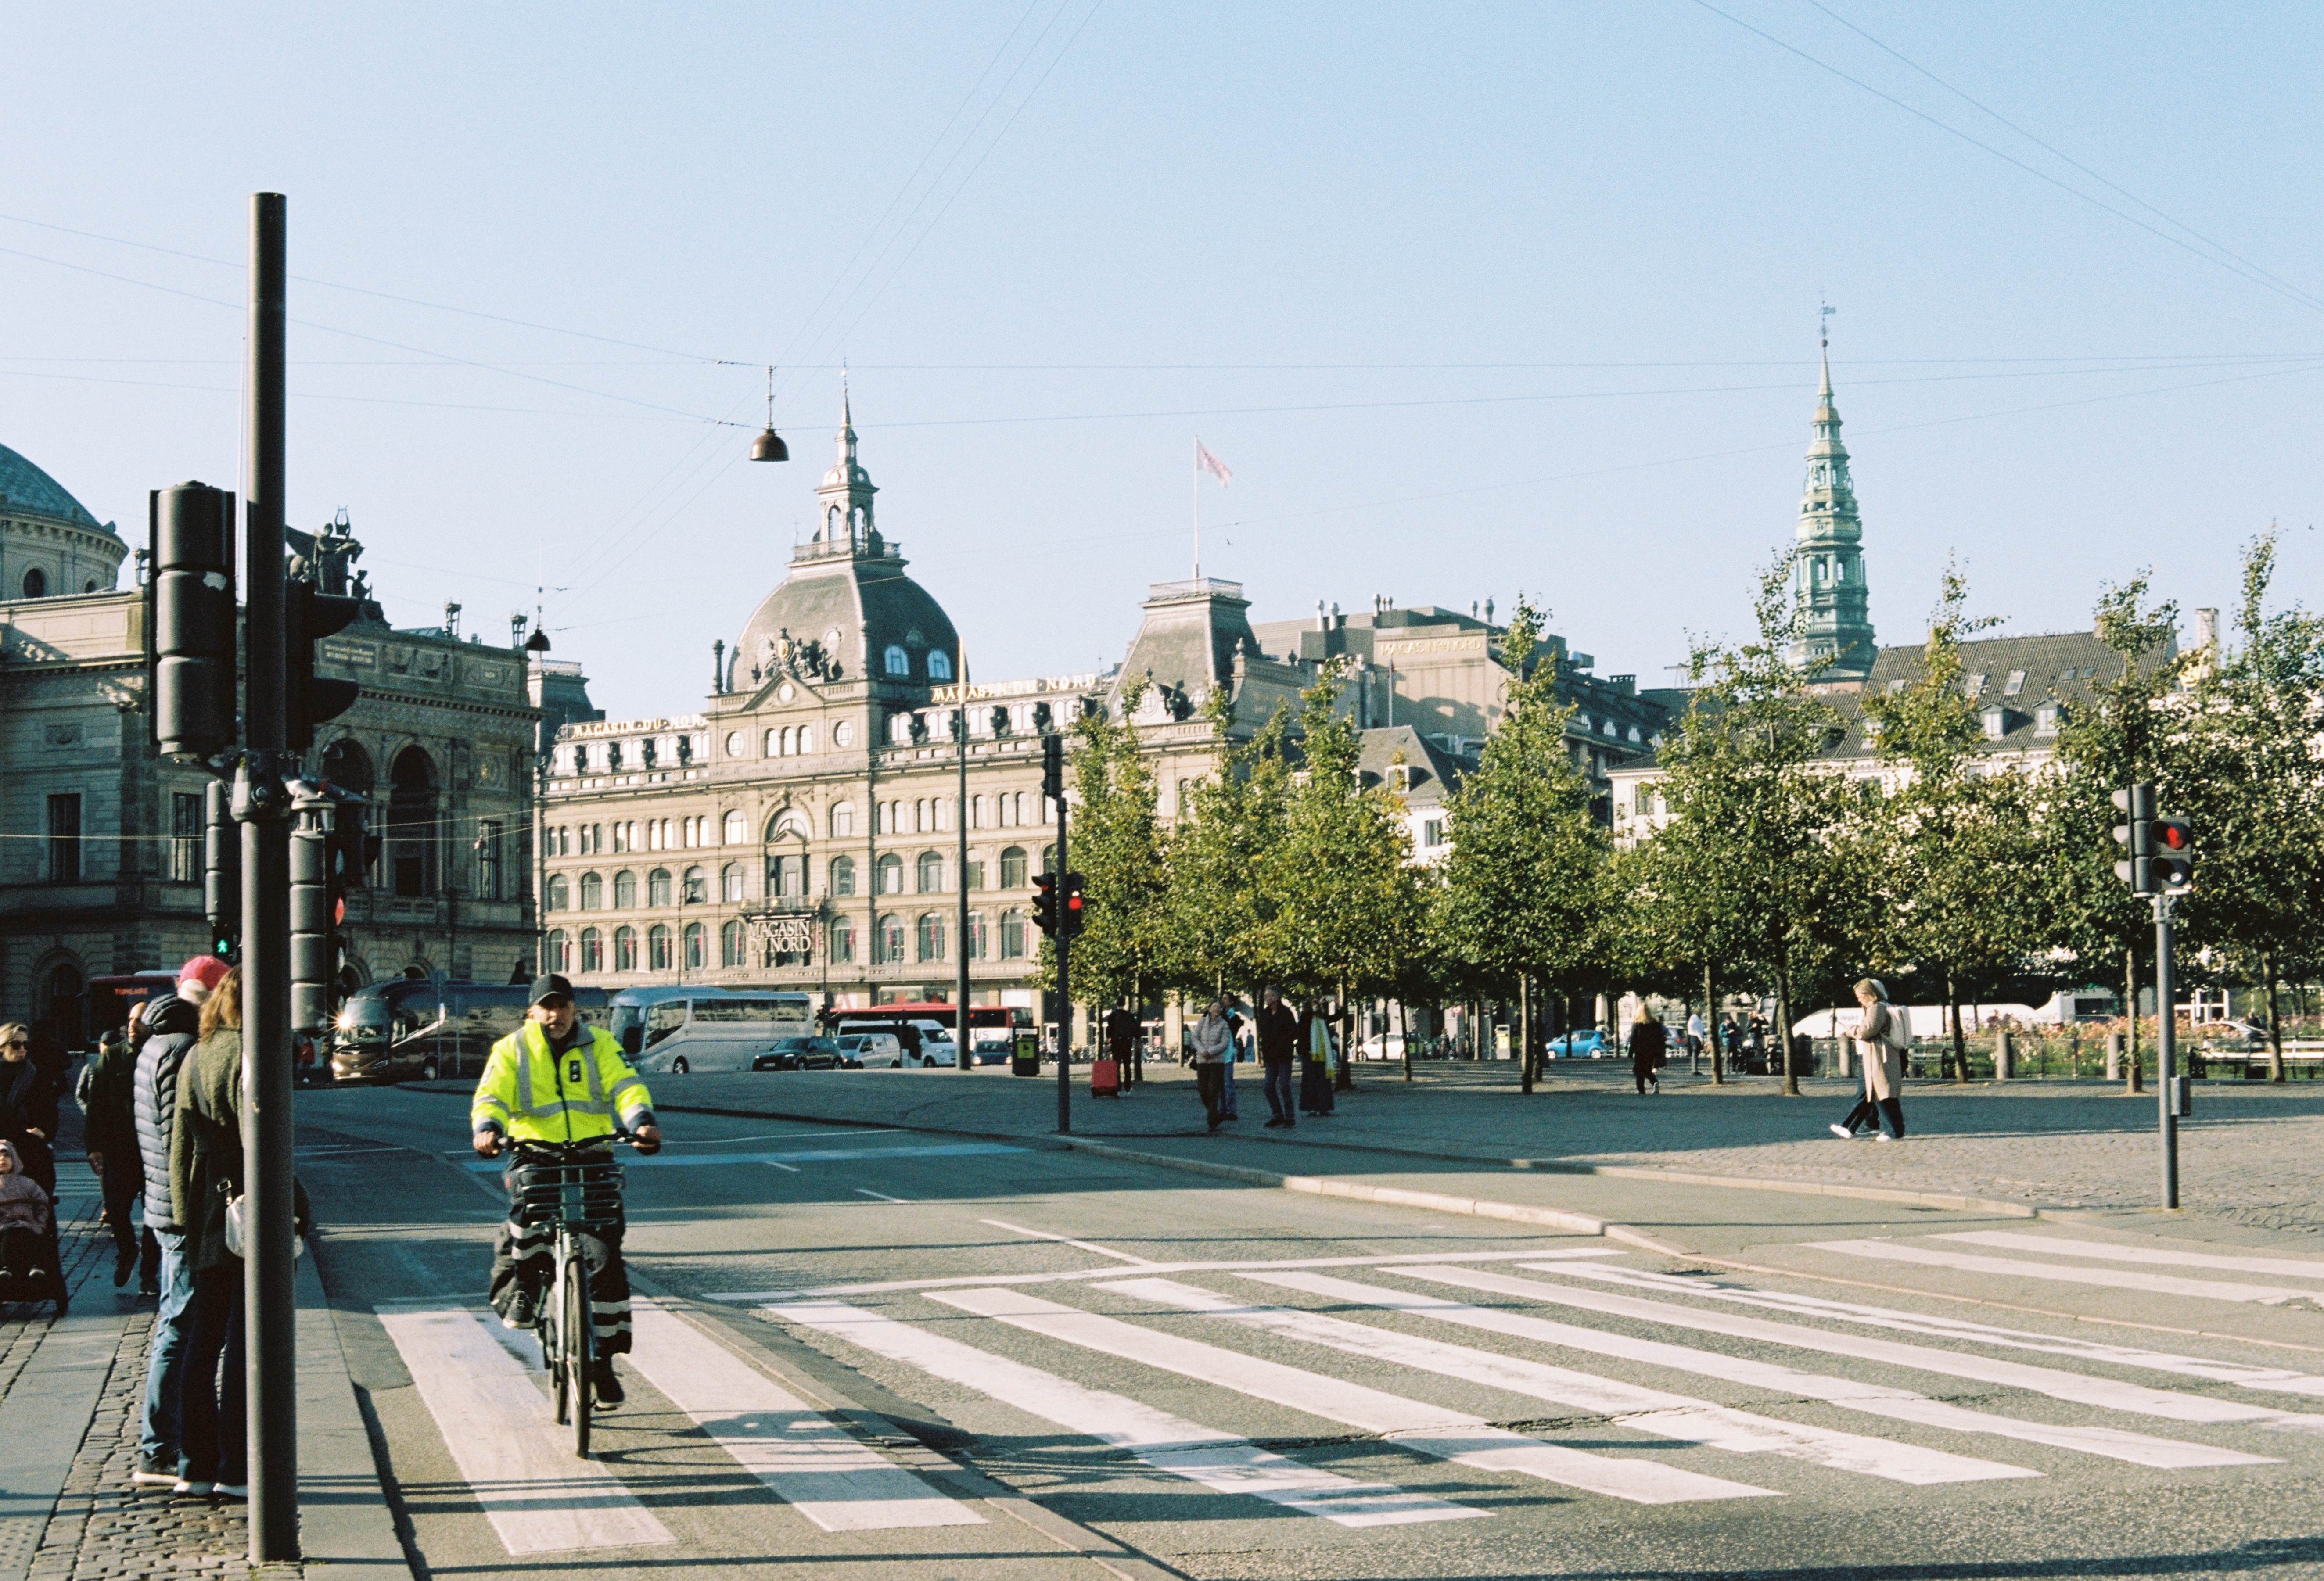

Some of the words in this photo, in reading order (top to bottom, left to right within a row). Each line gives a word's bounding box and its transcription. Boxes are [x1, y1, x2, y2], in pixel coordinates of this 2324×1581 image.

[1046, 674, 1095, 692] NORD
[571, 721, 635, 739] MAGASIN
[643, 718, 661, 731] DU
[747, 921, 810, 938] MAGASIN
[749, 936, 768, 954] DU
[769, 936, 812, 953] NORD
